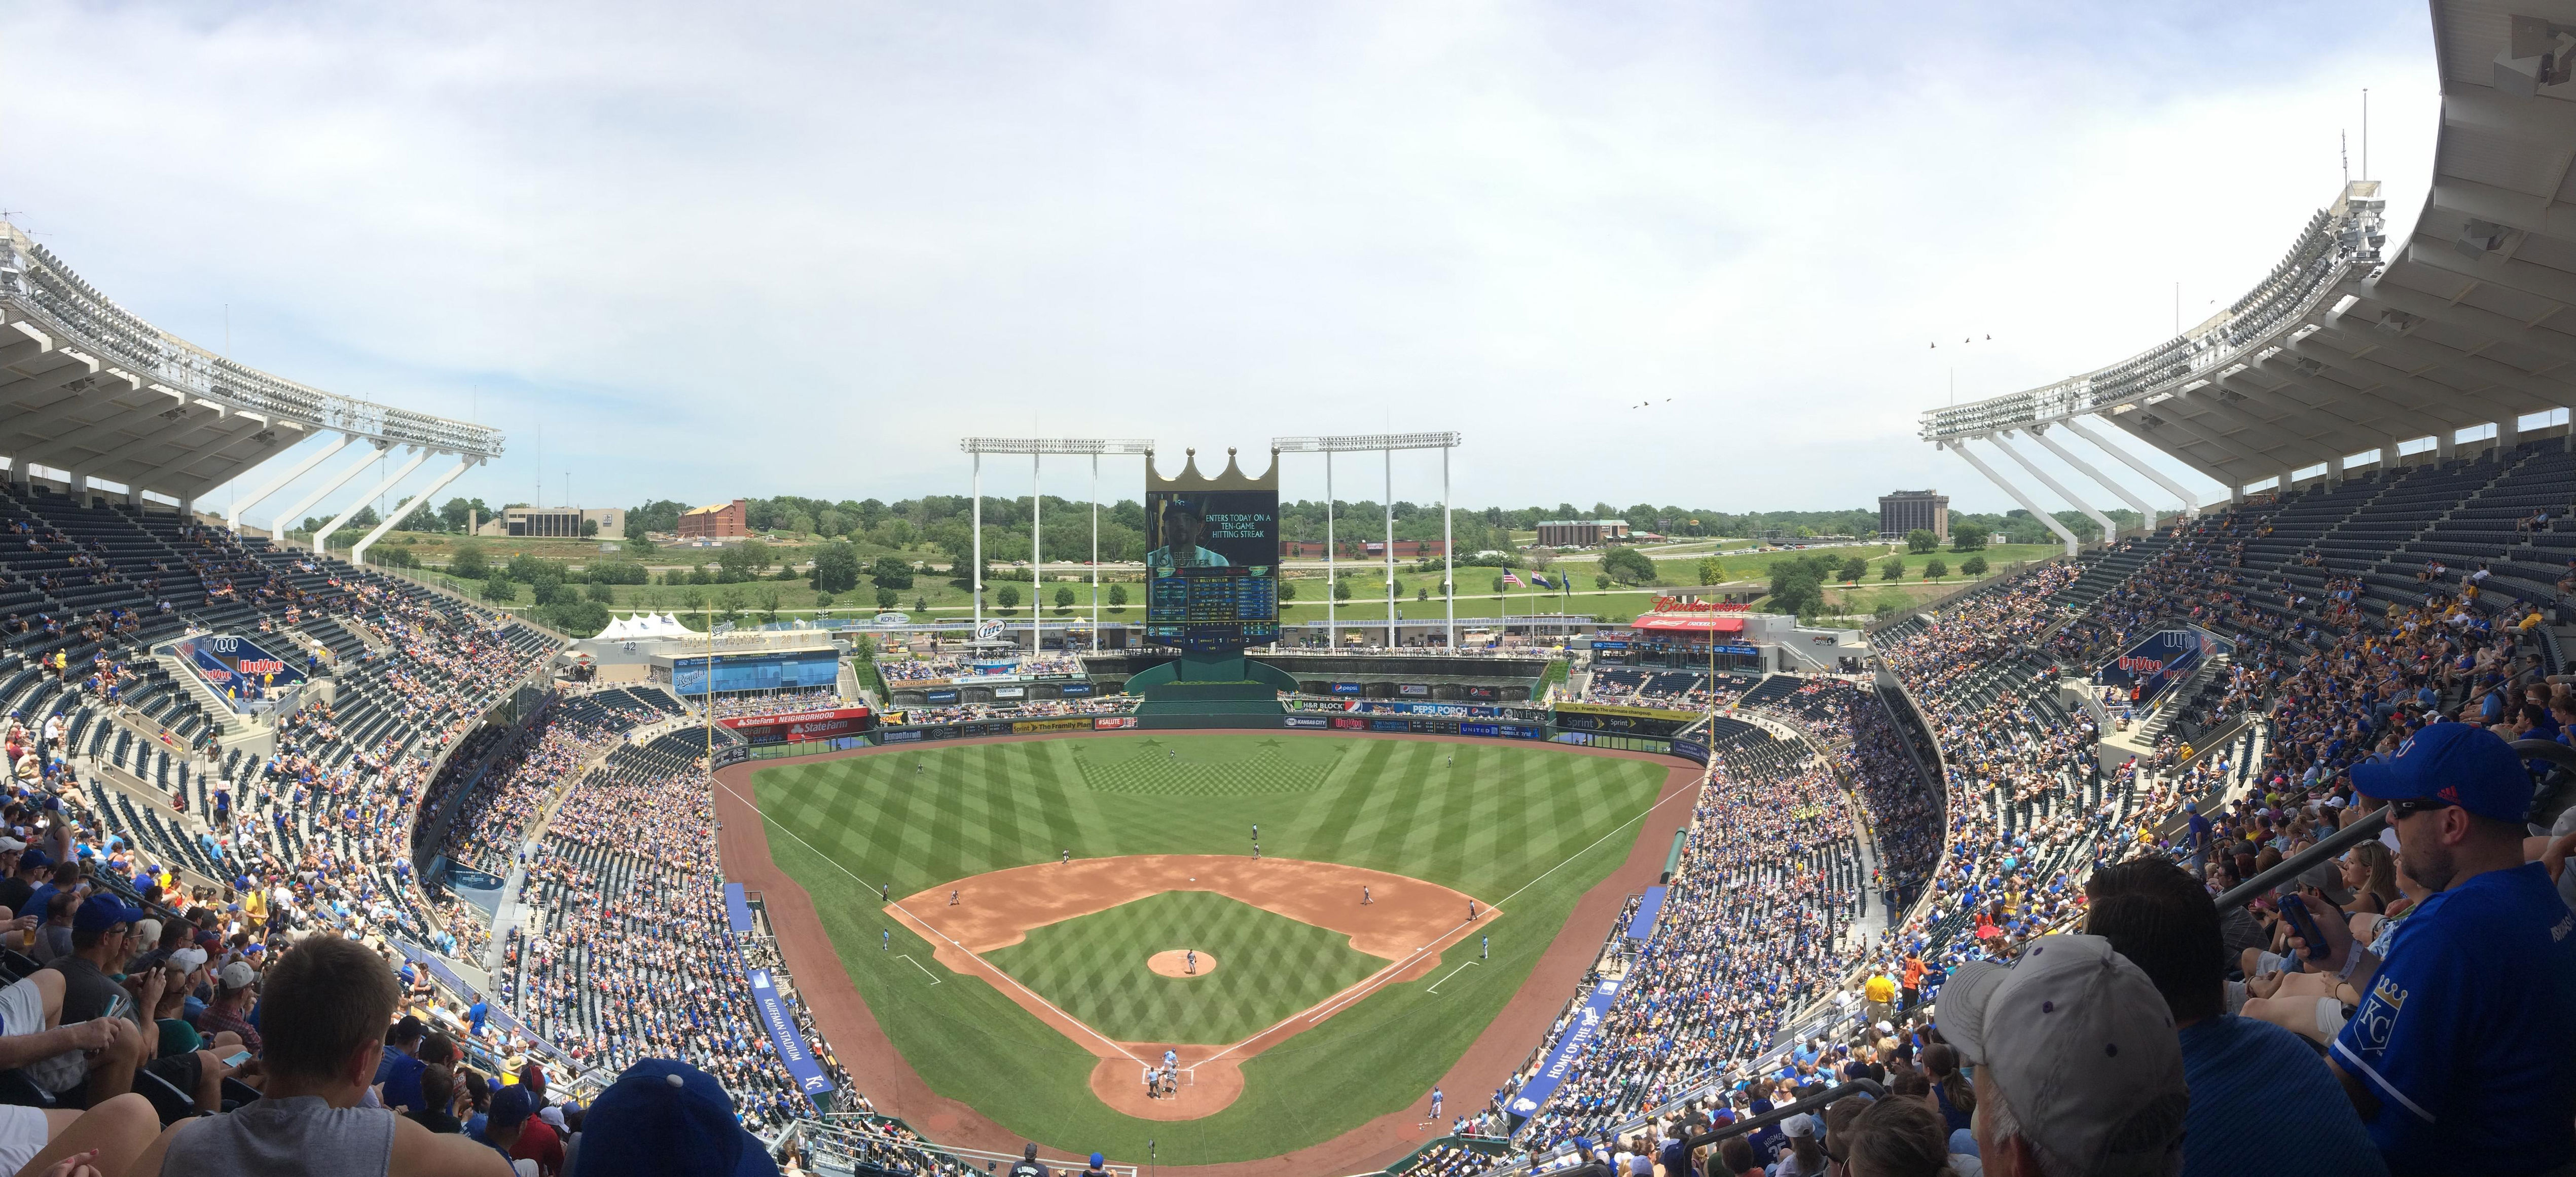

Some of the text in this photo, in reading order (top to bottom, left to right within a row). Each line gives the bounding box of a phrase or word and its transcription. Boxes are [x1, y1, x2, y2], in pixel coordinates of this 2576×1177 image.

[1206, 514, 1228, 522] ENTERS
[1651, 596, 1752, 612] Budweiser
[707, 619, 735, 637] Royals
[983, 624, 1002, 638] Lite
[681, 635, 761, 648] HALL of FAME
[780, 635, 792, 644] 20
[800, 634, 810, 643] 10
[821, 633, 826, 641] 5
[623, 642, 636, 651] 42
[240, 659, 284, 676] HyVee
[2119, 656, 2163, 674] HyVee
[676, 669, 705, 688] Royals
[1413, 705, 1467, 714] PEPSI PORCH
[778, 712, 835, 723] NEIGHBORHOOD
[1567, 717, 1593, 729] Sprint
[2360, 998, 2390, 1043] KC
[765, 998, 802, 1062] KAUFFMAN STADIUM
[1547, 1007, 1600, 1079] HOME OF THE Royals
[806, 1075, 824, 1091] KC
[1763, 1133, 1785, 1148] HOSMER
